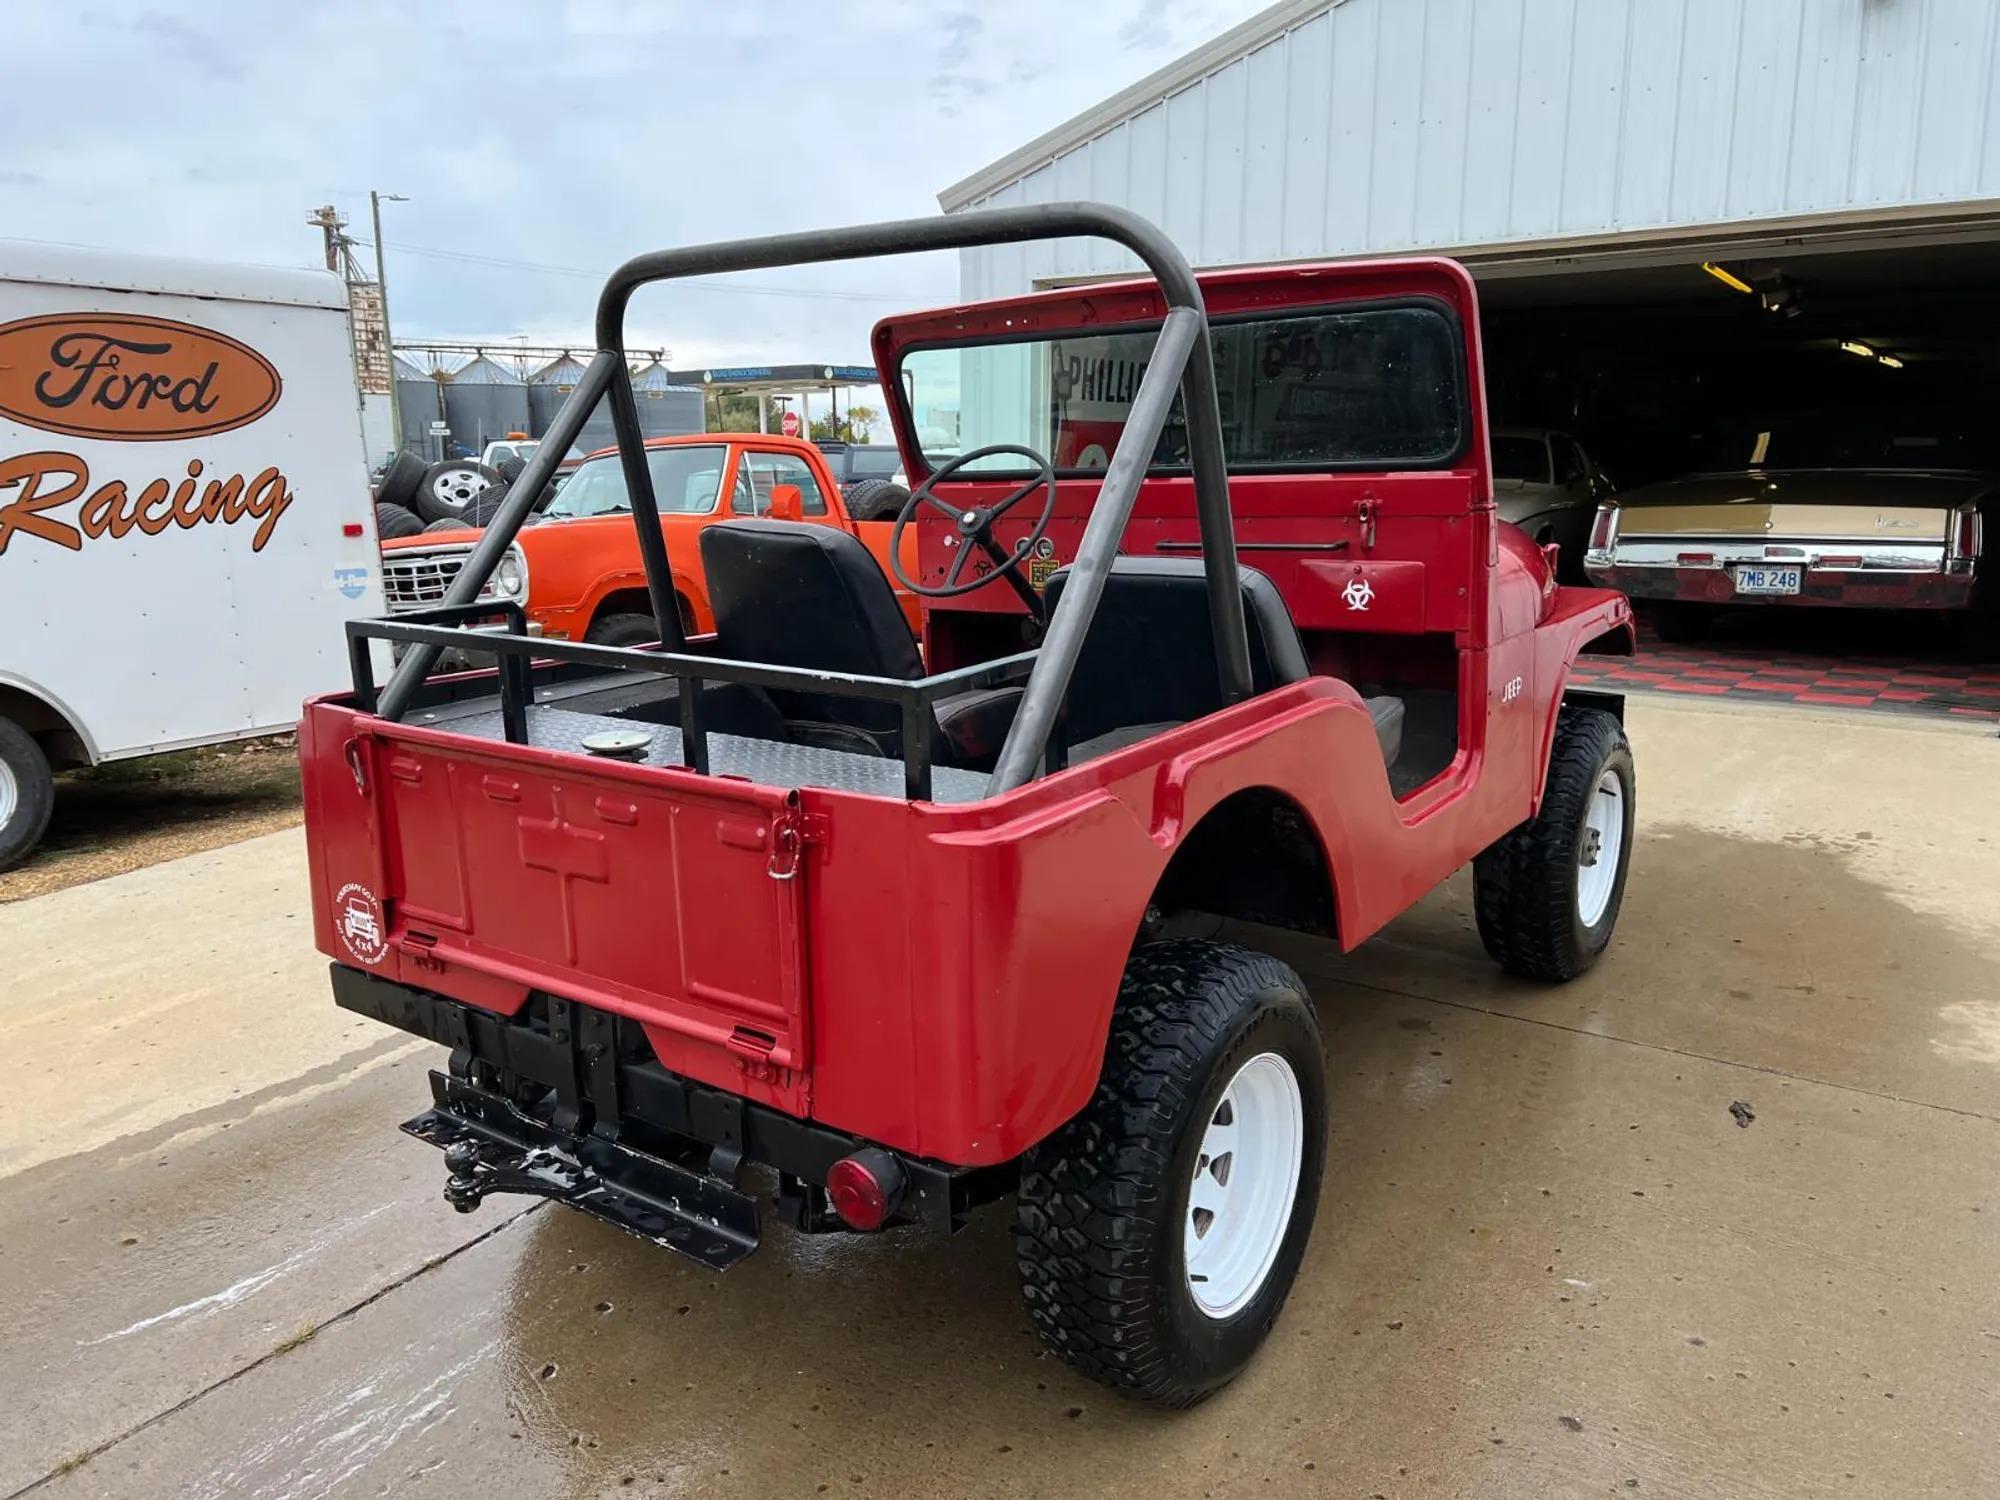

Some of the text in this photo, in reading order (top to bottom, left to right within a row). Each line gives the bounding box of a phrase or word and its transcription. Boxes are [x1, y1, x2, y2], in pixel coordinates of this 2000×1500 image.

[34, 333, 219, 414] Ford
[783, 420, 799, 431] STOP
[0, 451, 293, 555] Racing
[1739, 571, 1798, 588] 7MB 248
[1502, 676, 1522, 702] JEEP
